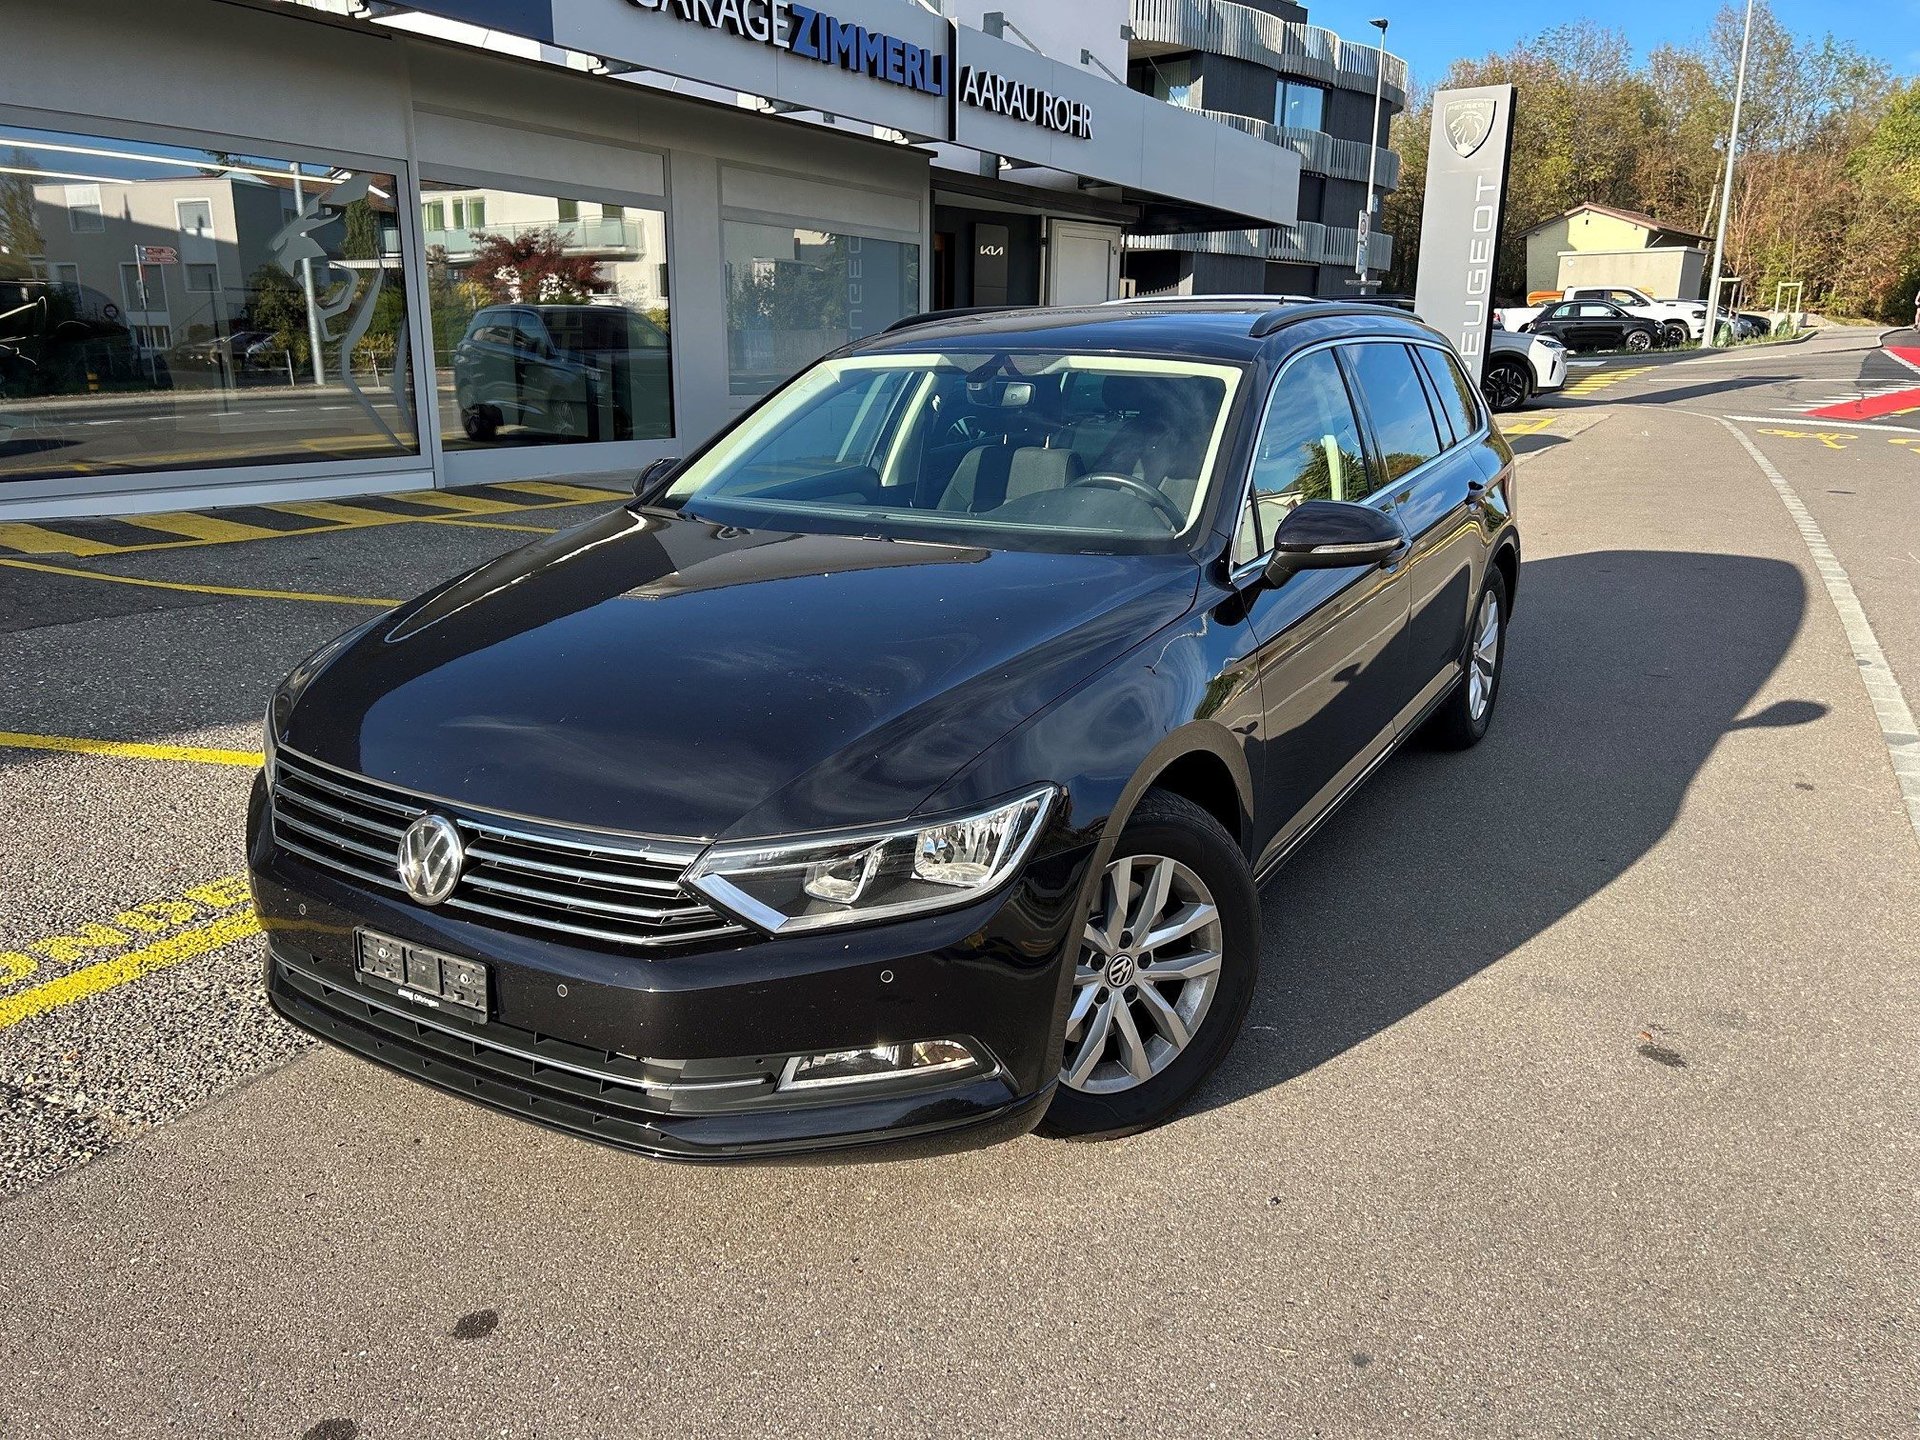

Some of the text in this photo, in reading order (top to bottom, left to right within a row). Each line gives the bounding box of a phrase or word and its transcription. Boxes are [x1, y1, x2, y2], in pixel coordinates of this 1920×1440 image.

[963, 66, 1094, 140] AARAU ROHR
[980, 245, 1004, 256] KIA
[1461, 175, 1496, 373] EUGEOT
